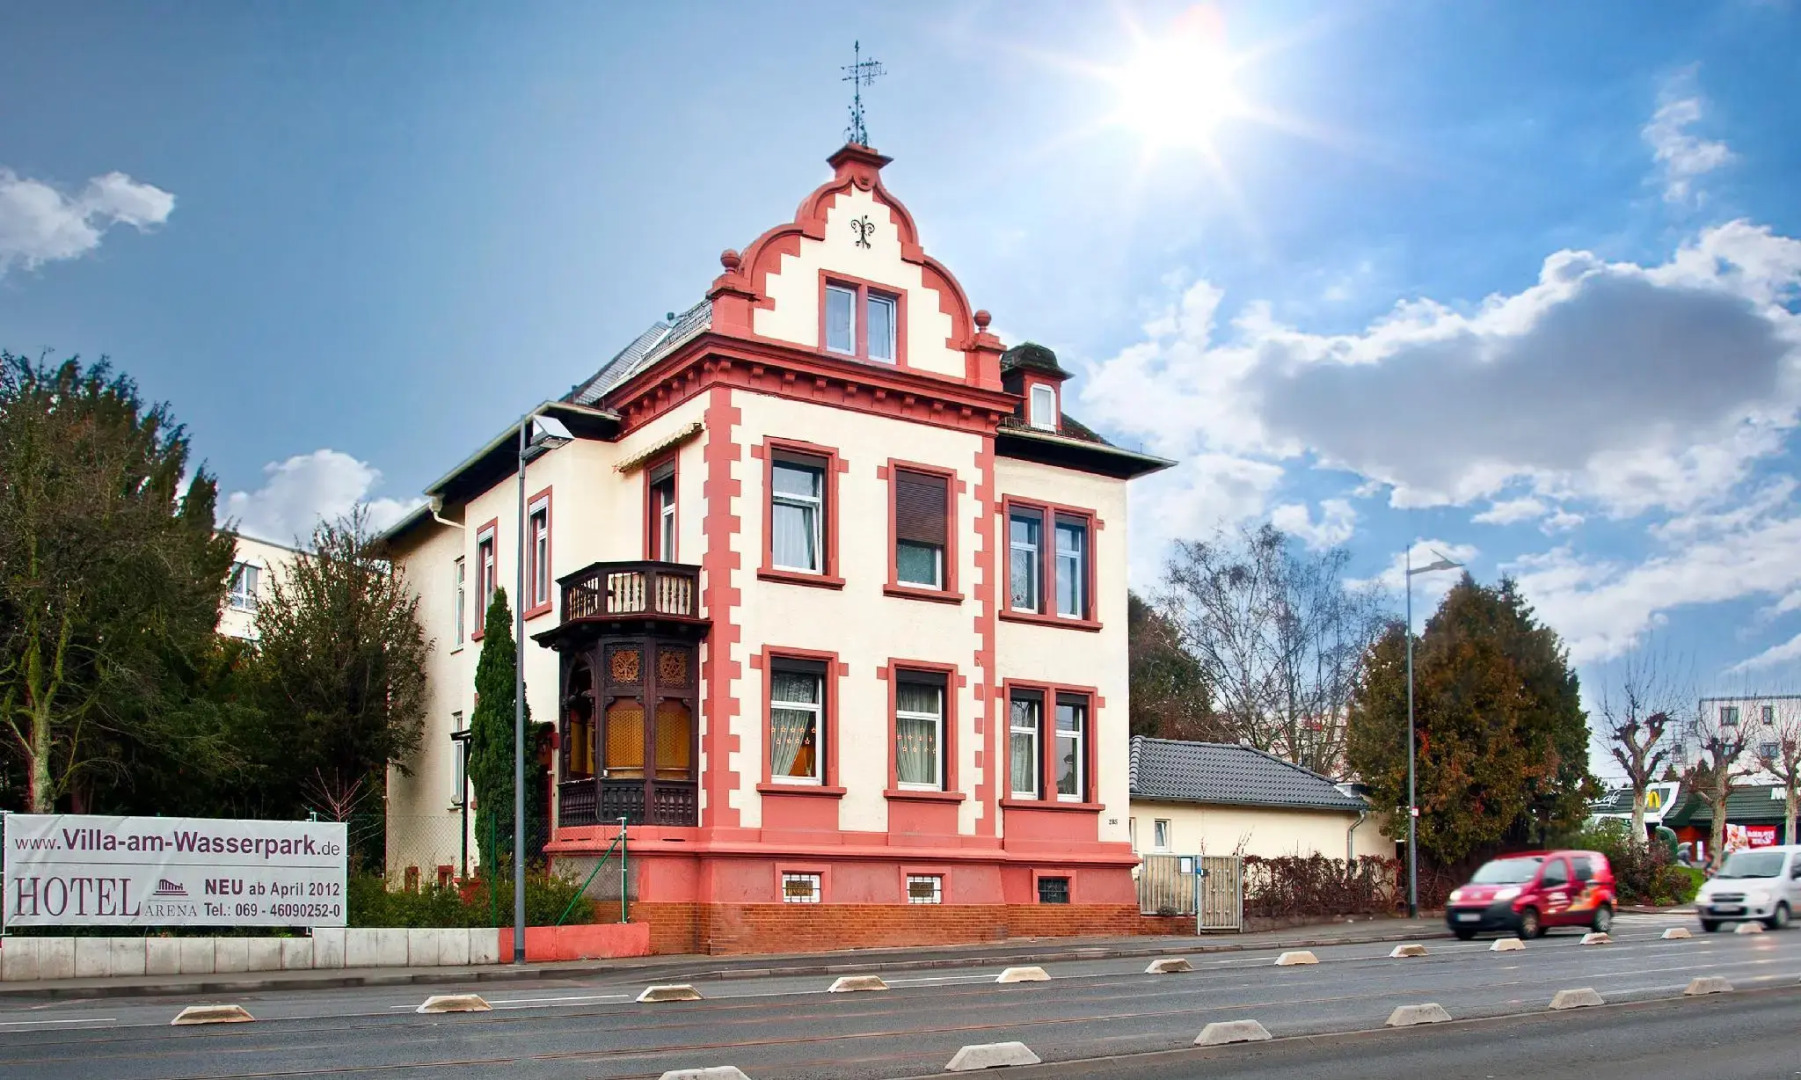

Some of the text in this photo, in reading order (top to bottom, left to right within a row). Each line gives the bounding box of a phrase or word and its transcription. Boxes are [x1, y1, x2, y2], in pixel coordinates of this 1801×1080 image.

[15, 828, 340, 859] www.Villa-am-Wasserpark.de
[14, 876, 197, 917] HOTEL ARENA
[205, 879, 340, 899] NEU ab April 2012
[204, 902, 231, 917] Tel.:
[235, 903, 258, 917] 069
[270, 903, 340, 917] 46090252-0
